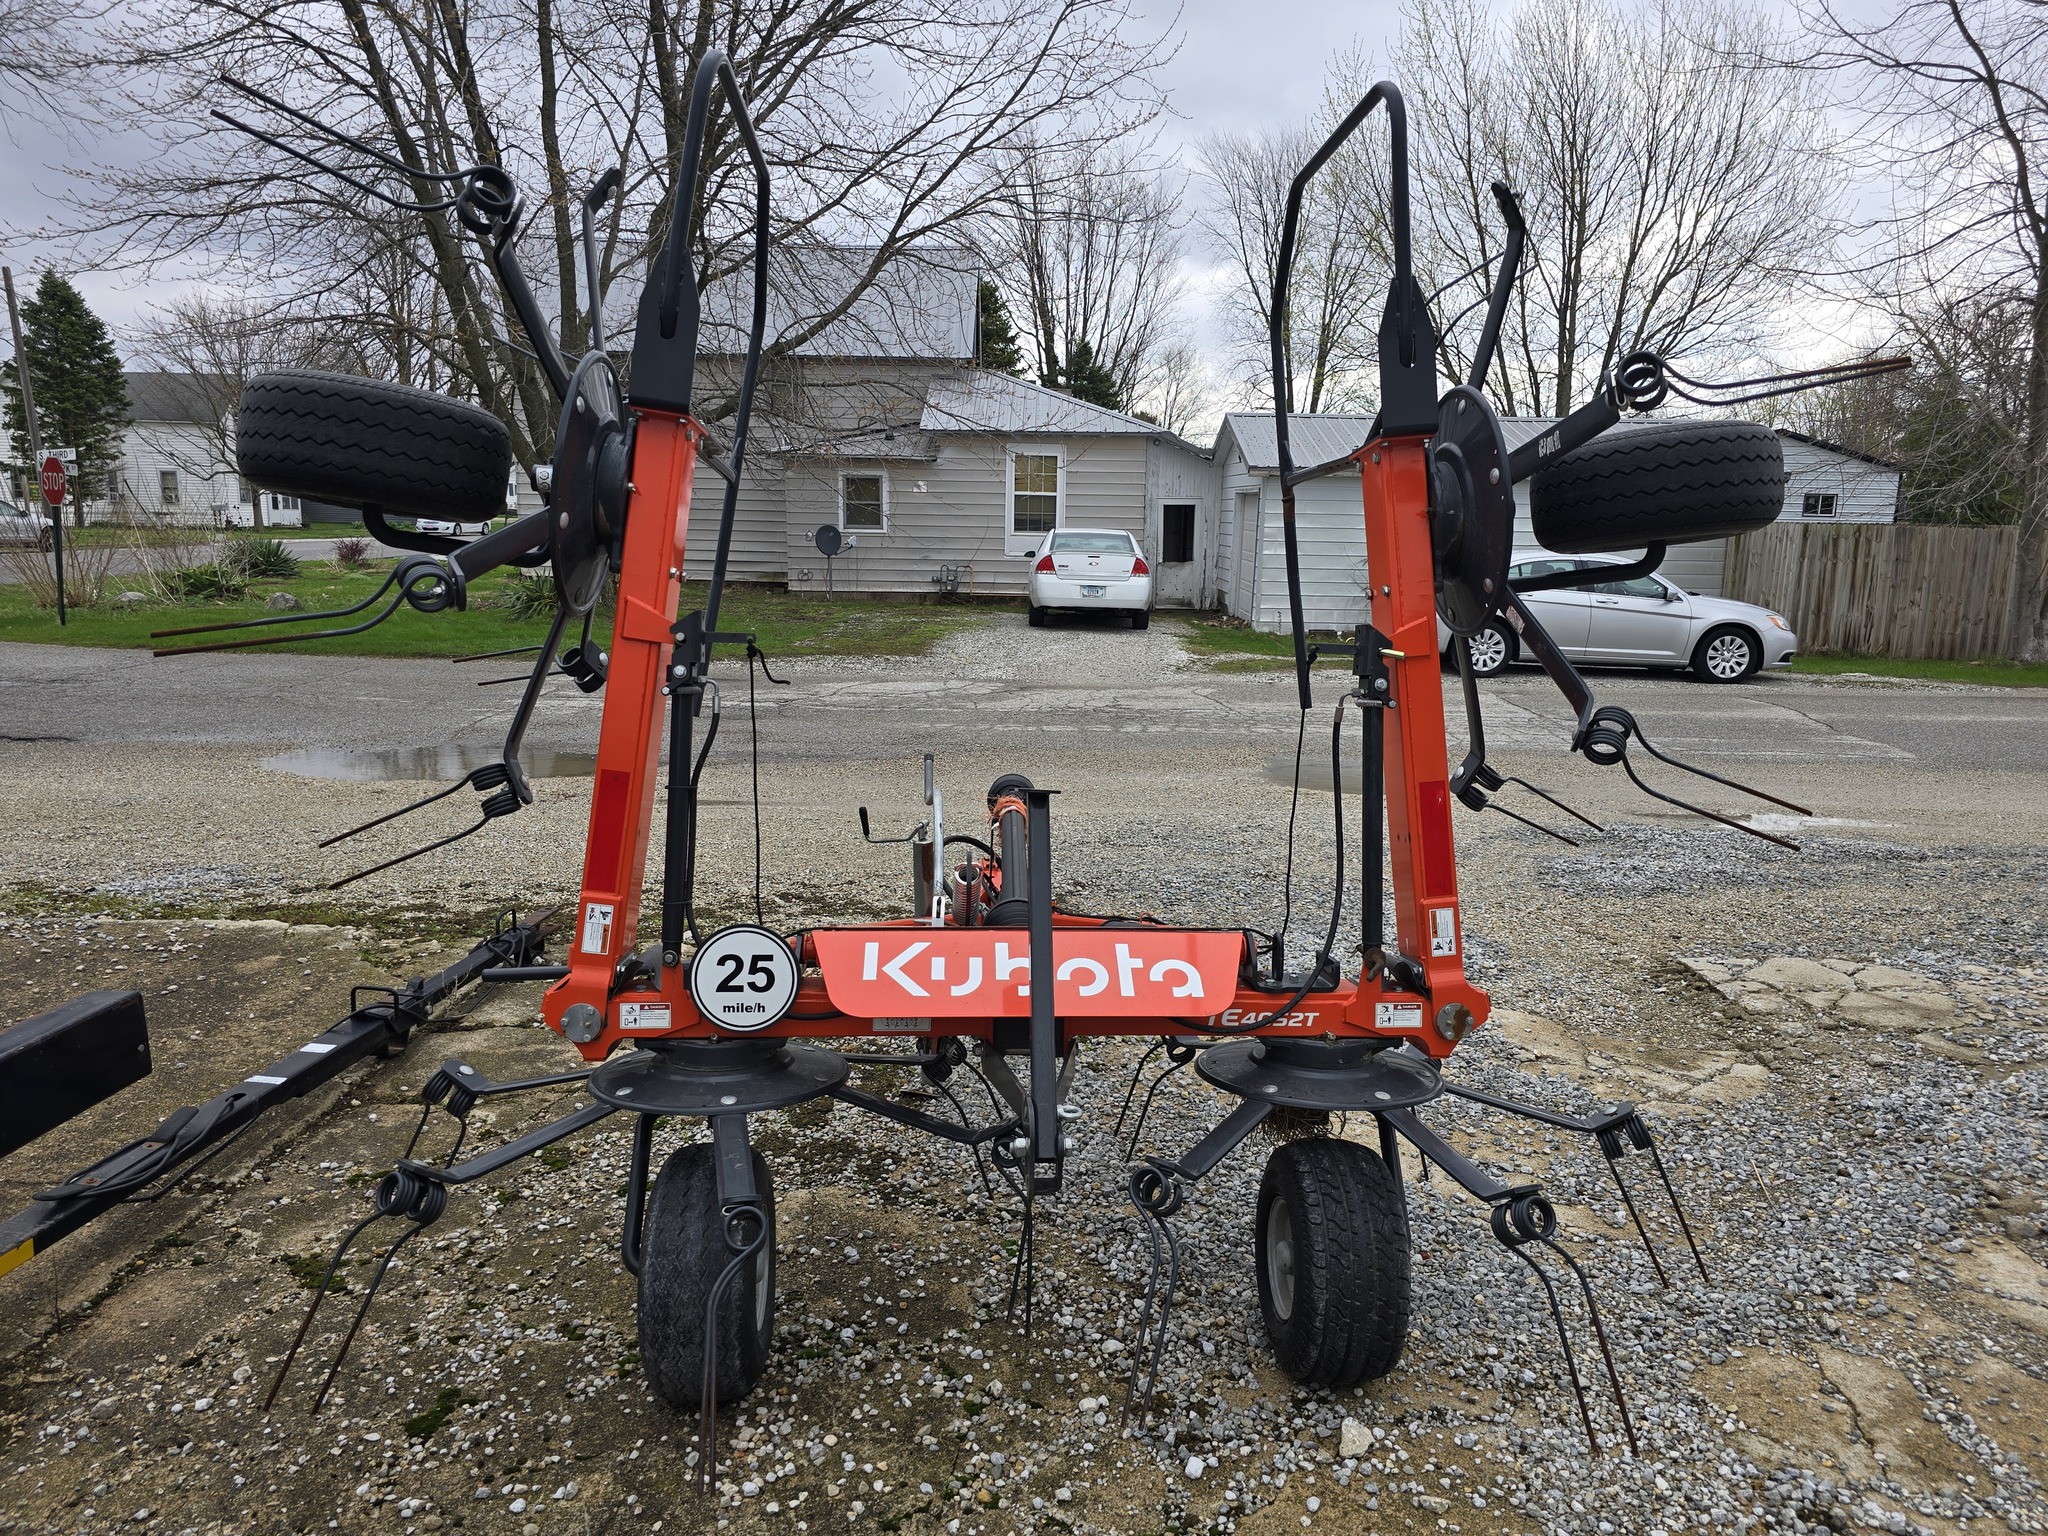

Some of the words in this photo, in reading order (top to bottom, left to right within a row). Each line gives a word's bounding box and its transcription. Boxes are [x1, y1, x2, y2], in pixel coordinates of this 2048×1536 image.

[39, 451, 44, 460] S
[48, 450, 69, 459] THIRD
[43, 472, 65, 490] STOP
[715, 953, 776, 993] 25
[862, 942, 1205, 998] Kubota
[722, 1002, 766, 1013] mile/h
